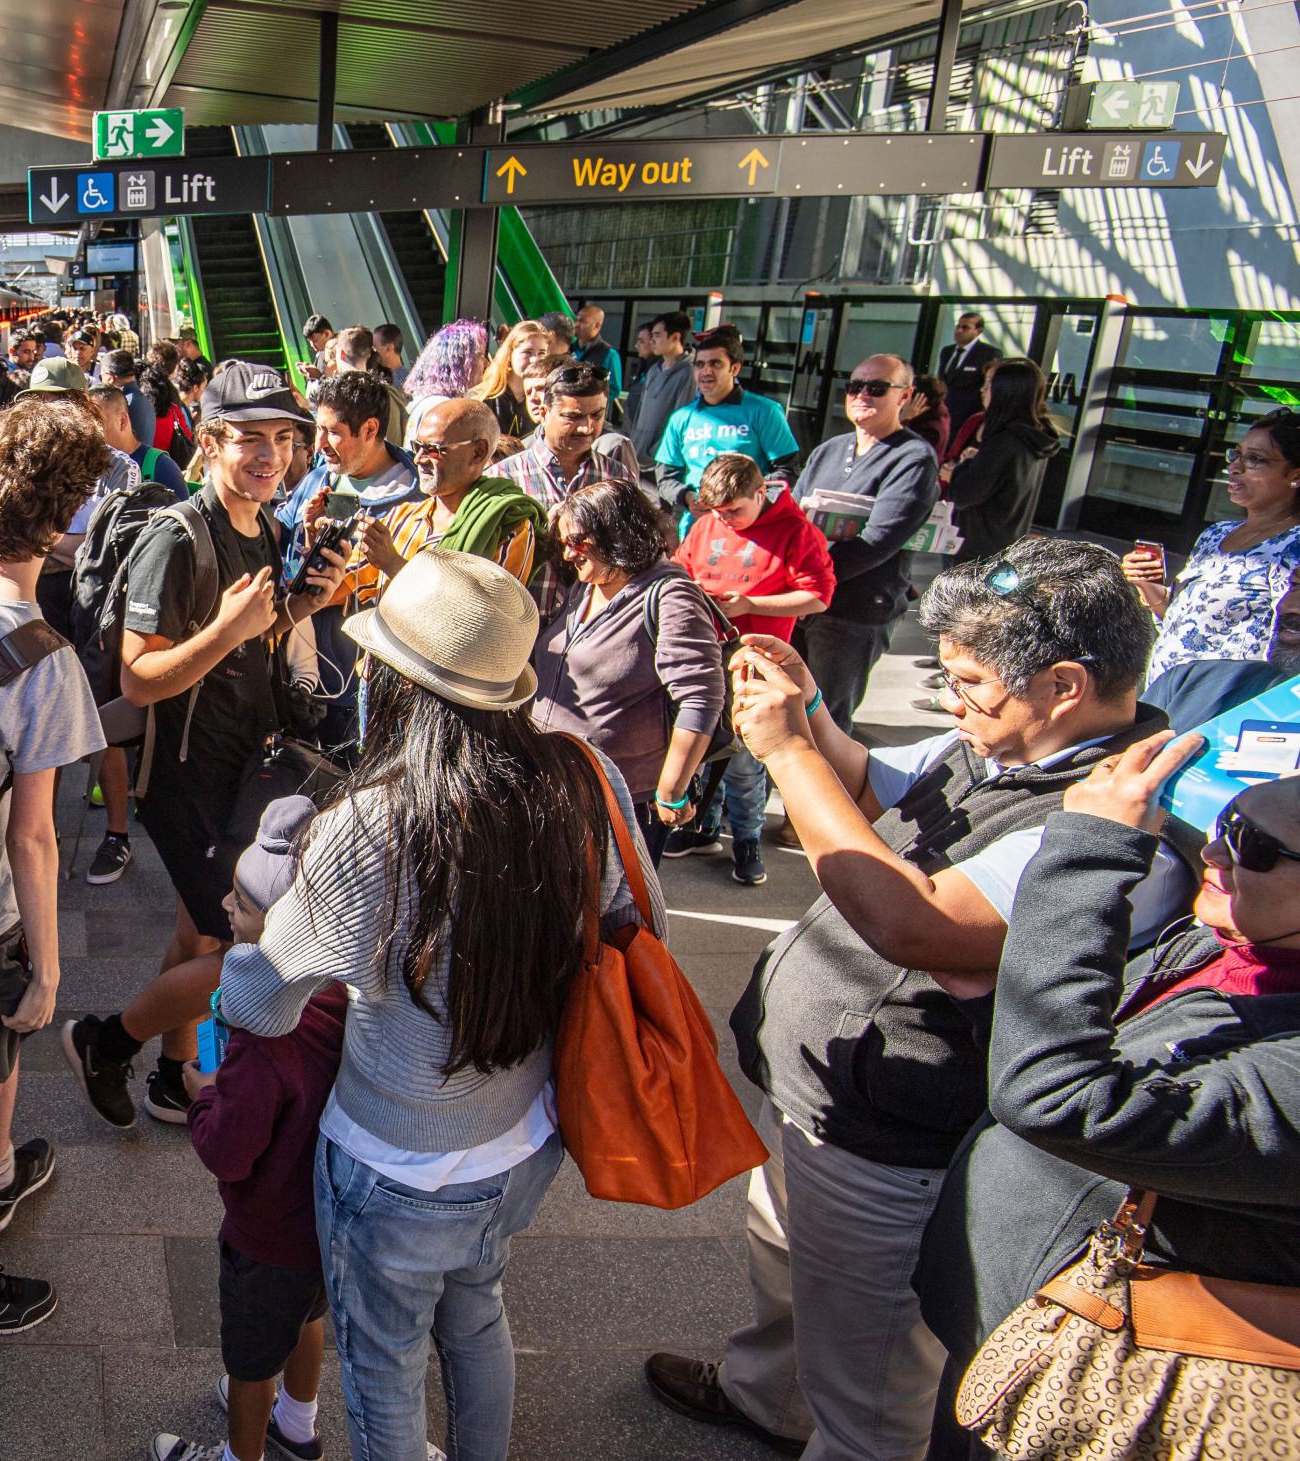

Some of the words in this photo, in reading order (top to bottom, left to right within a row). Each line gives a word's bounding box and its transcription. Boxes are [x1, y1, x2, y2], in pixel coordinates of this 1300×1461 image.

[1042, 146, 1093, 175] Lift
[572, 158, 636, 192] Way
[641, 157, 693, 184] out
[165, 174, 216, 203] Lift
[72, 265, 80, 275] 2
[253, 373, 283, 388] NIKE
[684, 422, 712, 443] Ask
[717, 424, 749, 438] me
